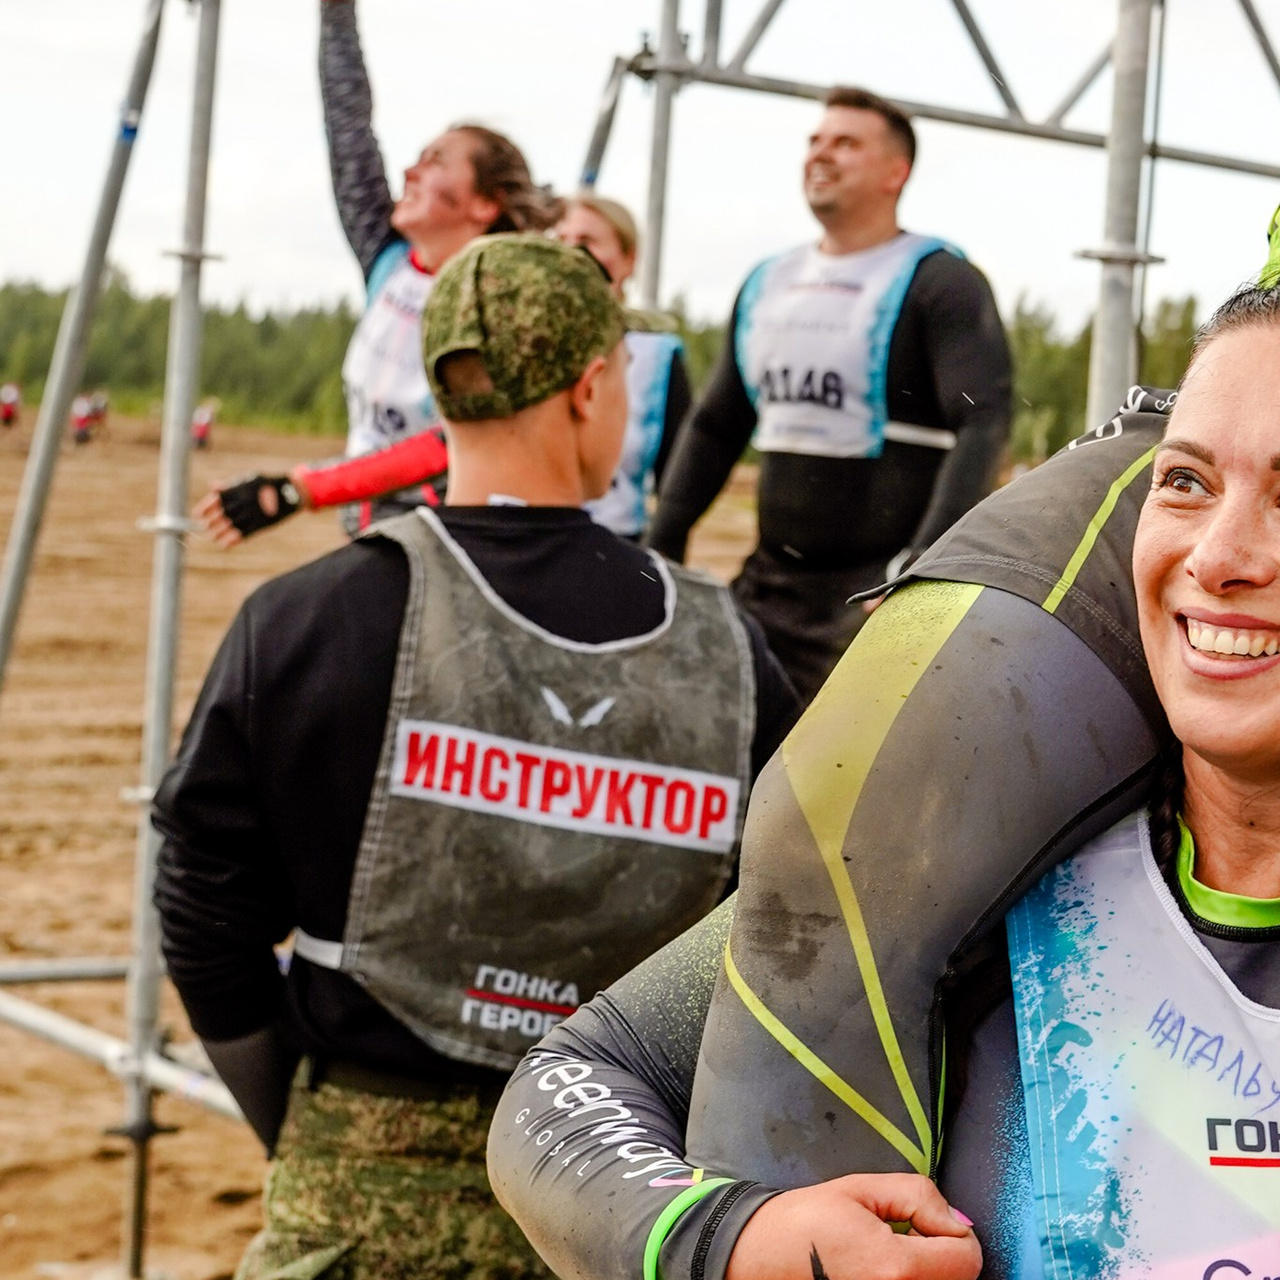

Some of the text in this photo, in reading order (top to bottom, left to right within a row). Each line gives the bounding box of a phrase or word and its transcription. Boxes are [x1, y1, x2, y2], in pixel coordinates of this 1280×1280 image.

[403, 731, 729, 841] ИНСТРУКТОР
[474, 964, 580, 1007] ГОНКА
[515, 1107, 591, 1176] GLOBAL
